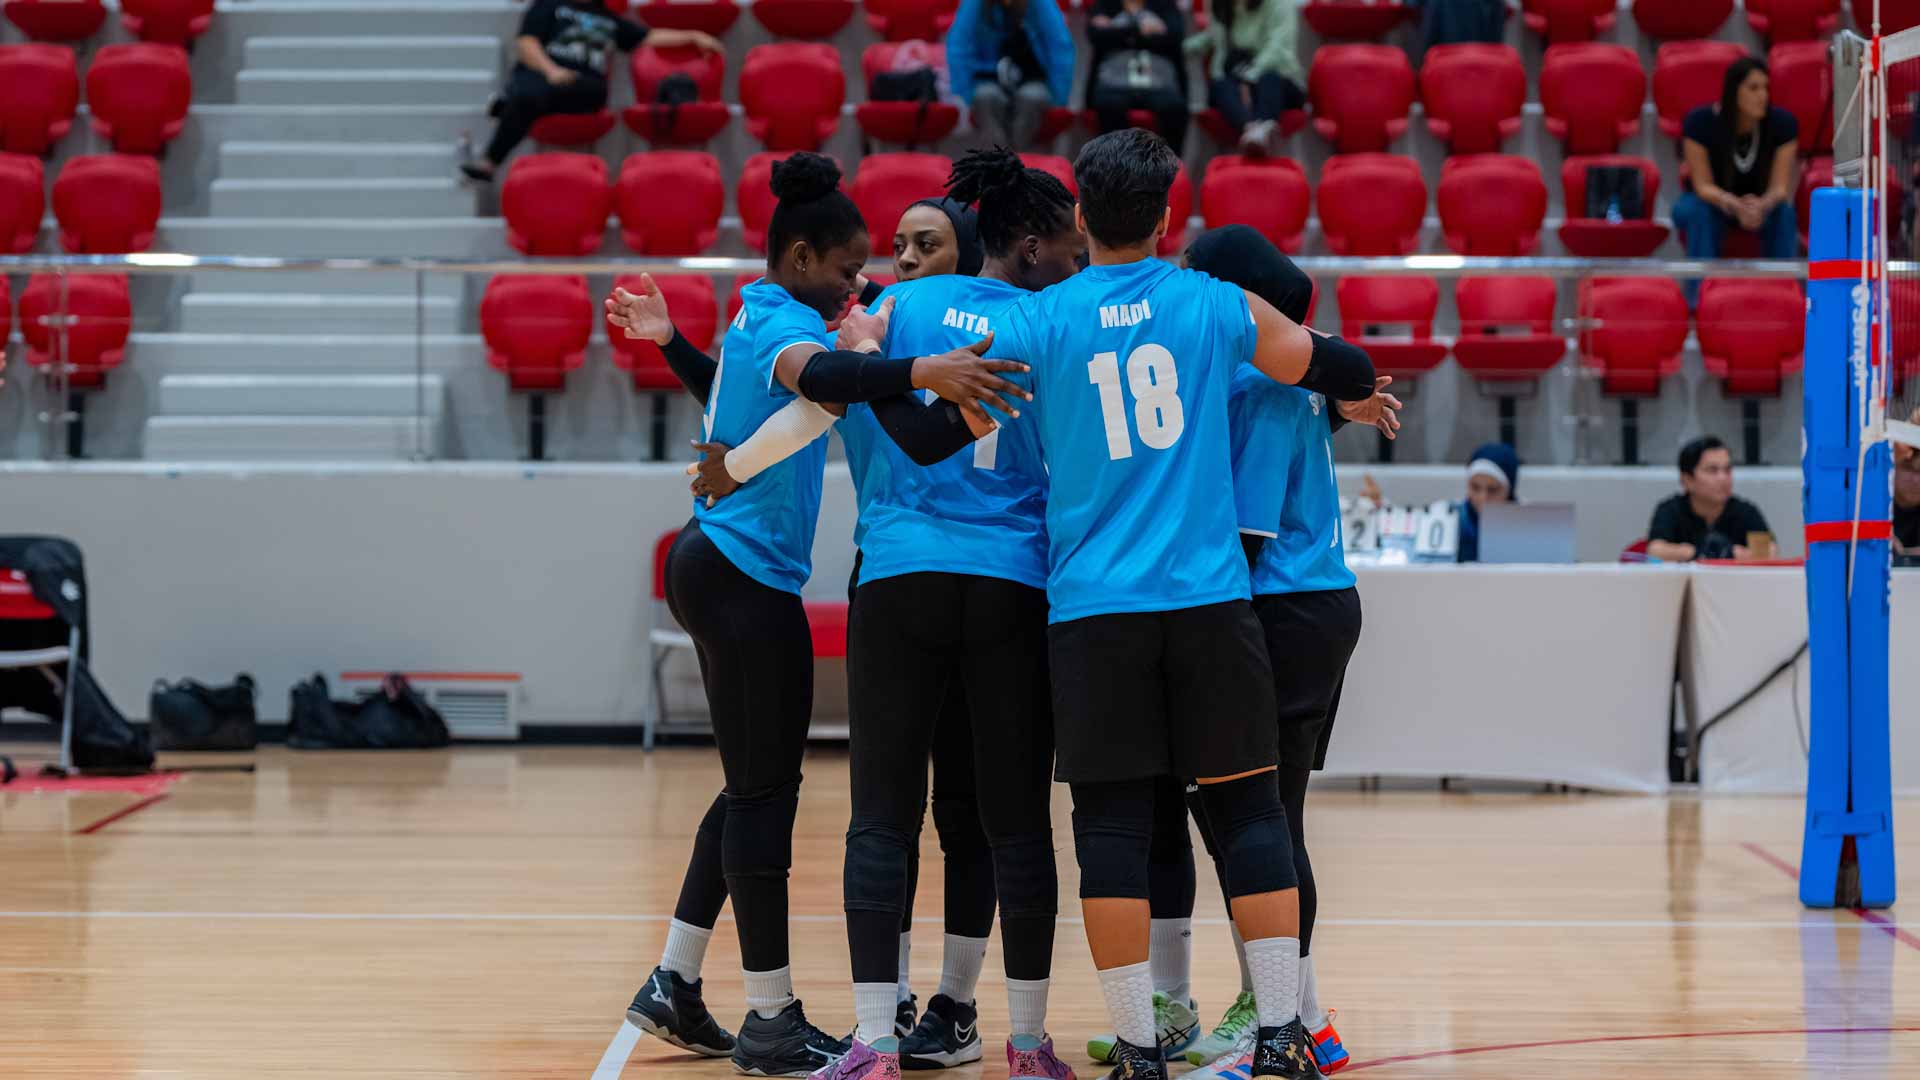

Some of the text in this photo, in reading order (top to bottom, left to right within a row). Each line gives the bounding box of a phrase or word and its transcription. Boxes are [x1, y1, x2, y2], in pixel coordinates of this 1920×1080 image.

[942, 307, 989, 336] AITA
[1099, 299, 1152, 329] MADI
[1087, 343, 1185, 461] 18
[1352, 520, 1366, 548] 2
